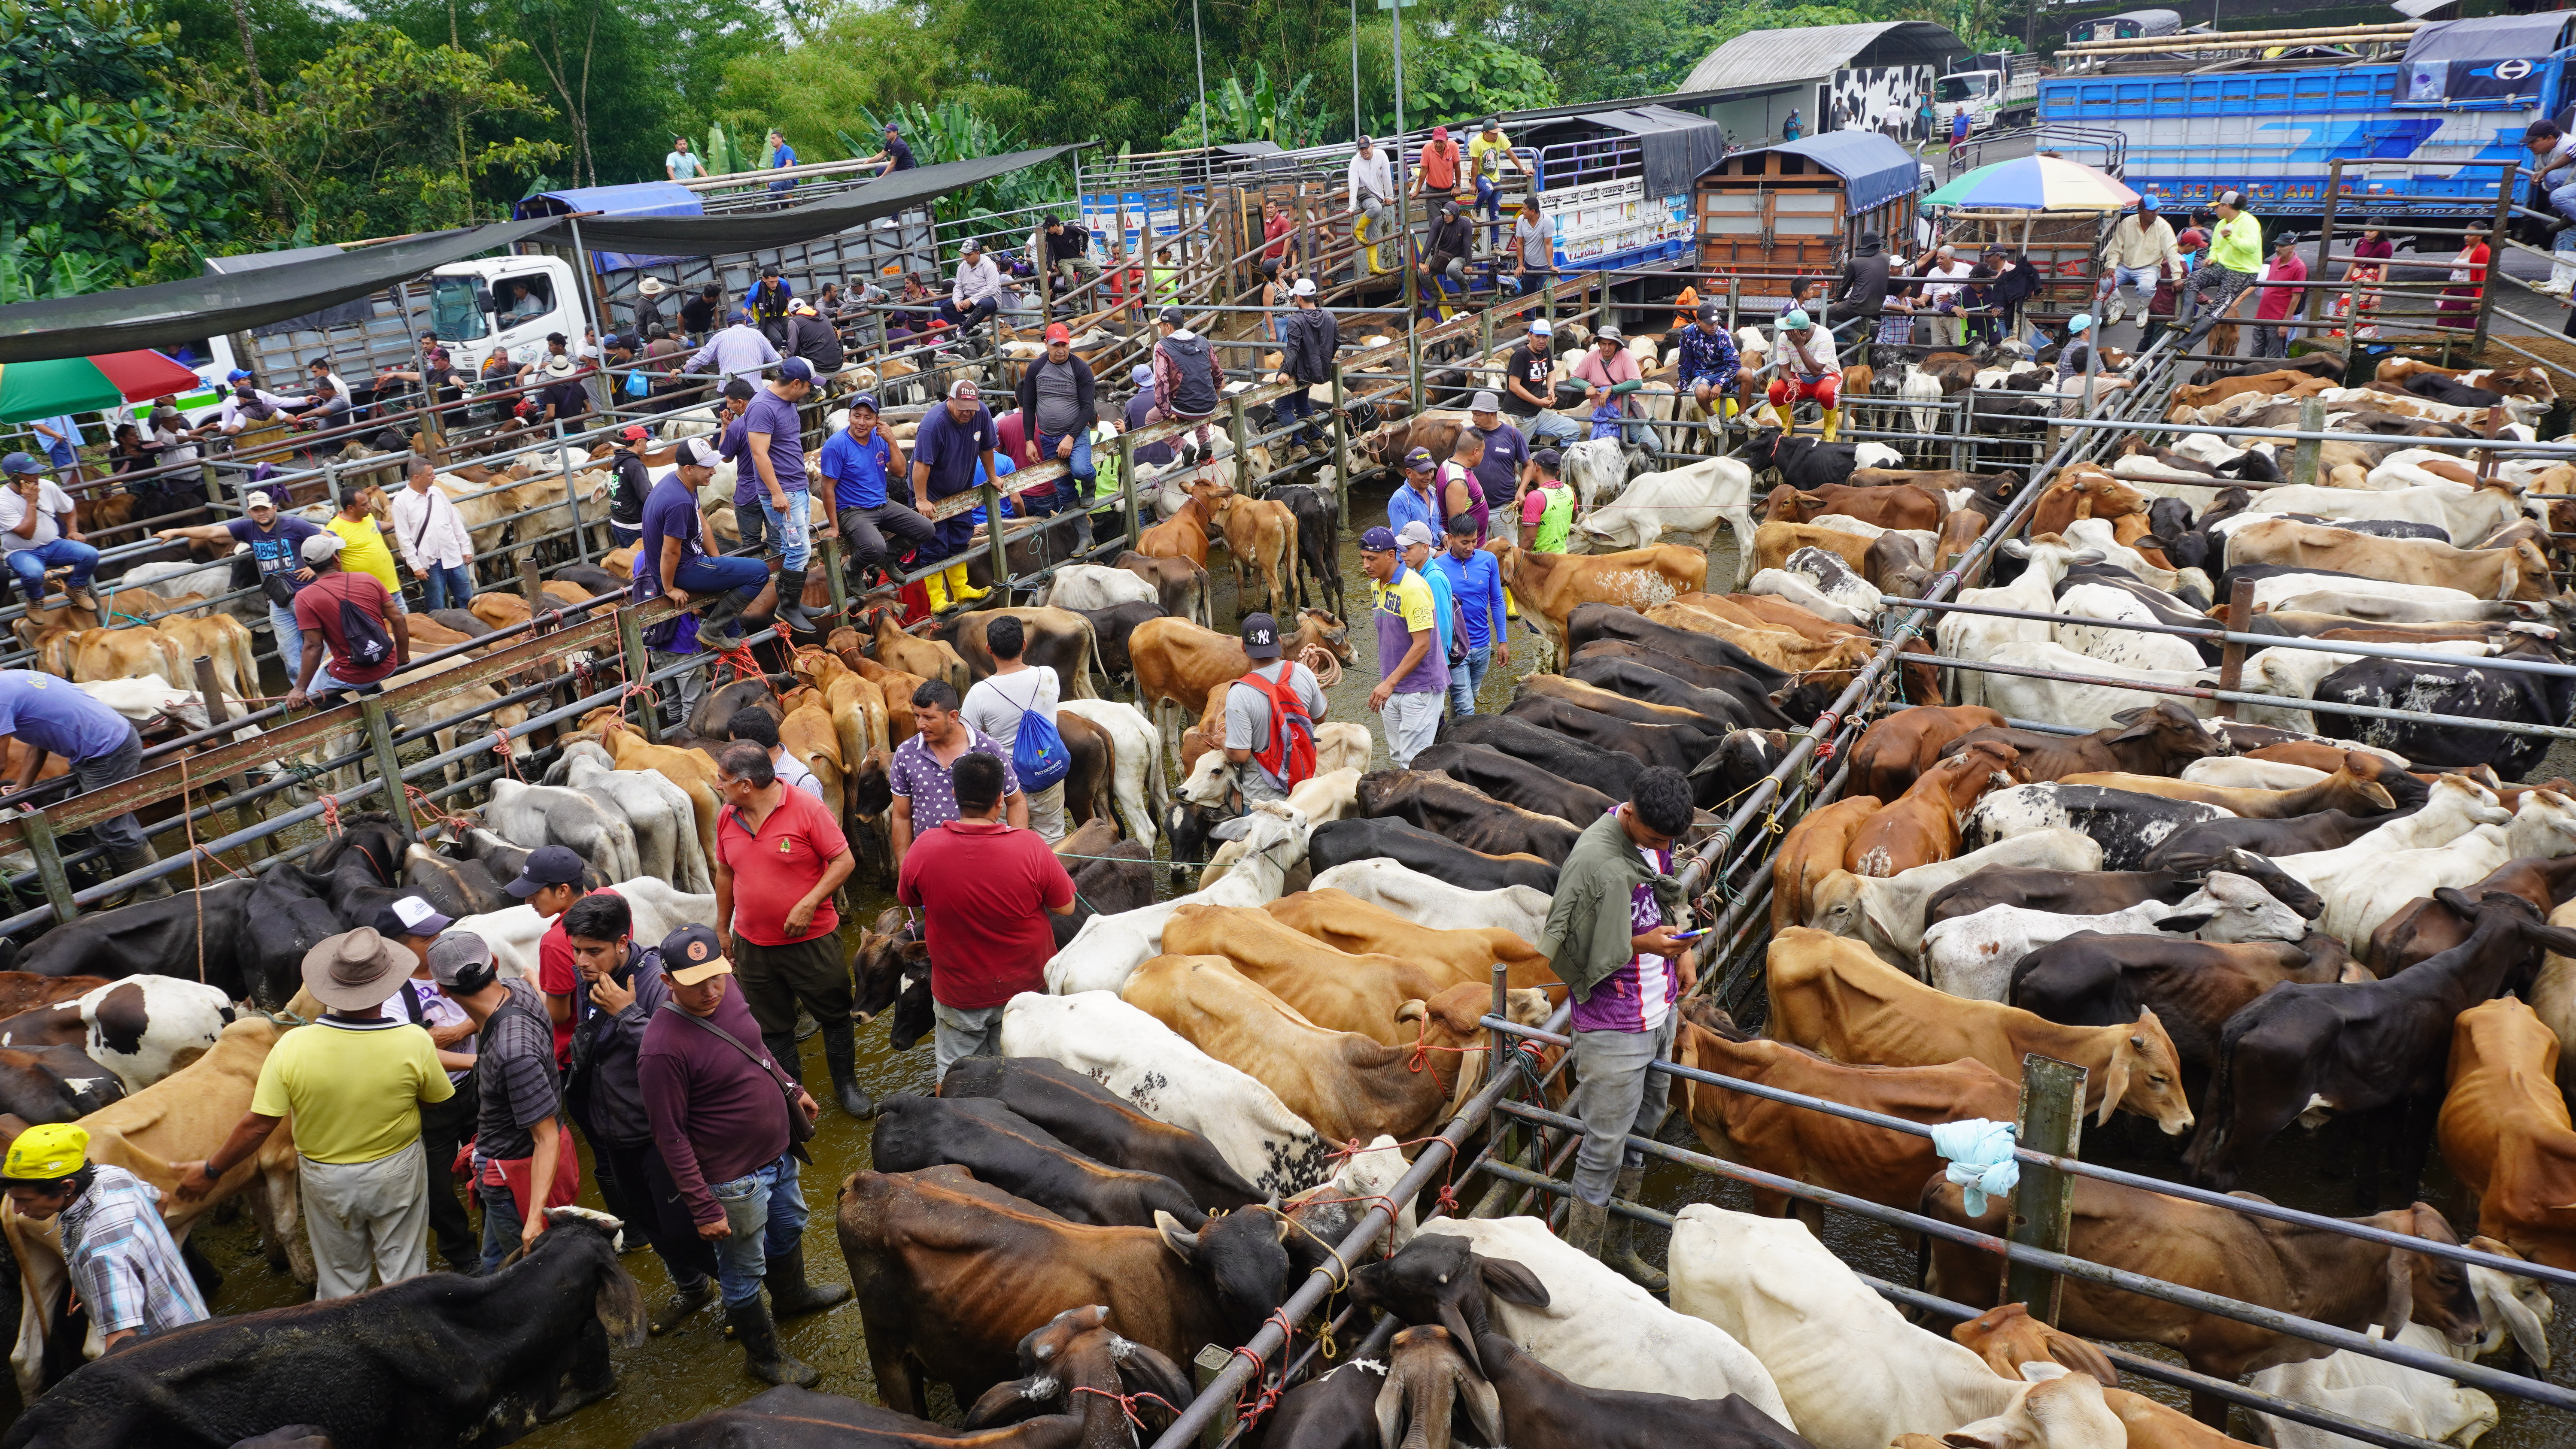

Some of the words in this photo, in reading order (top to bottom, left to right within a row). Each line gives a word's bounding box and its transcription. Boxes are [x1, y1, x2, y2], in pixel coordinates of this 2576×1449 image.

[259, 557, 292, 571] YN/NC
[1413, 606, 1430, 623] 85
[1257, 629, 1270, 645] NY
[364, 645, 383, 655] adidas
[1035, 760, 1061, 776] PATRONATO
